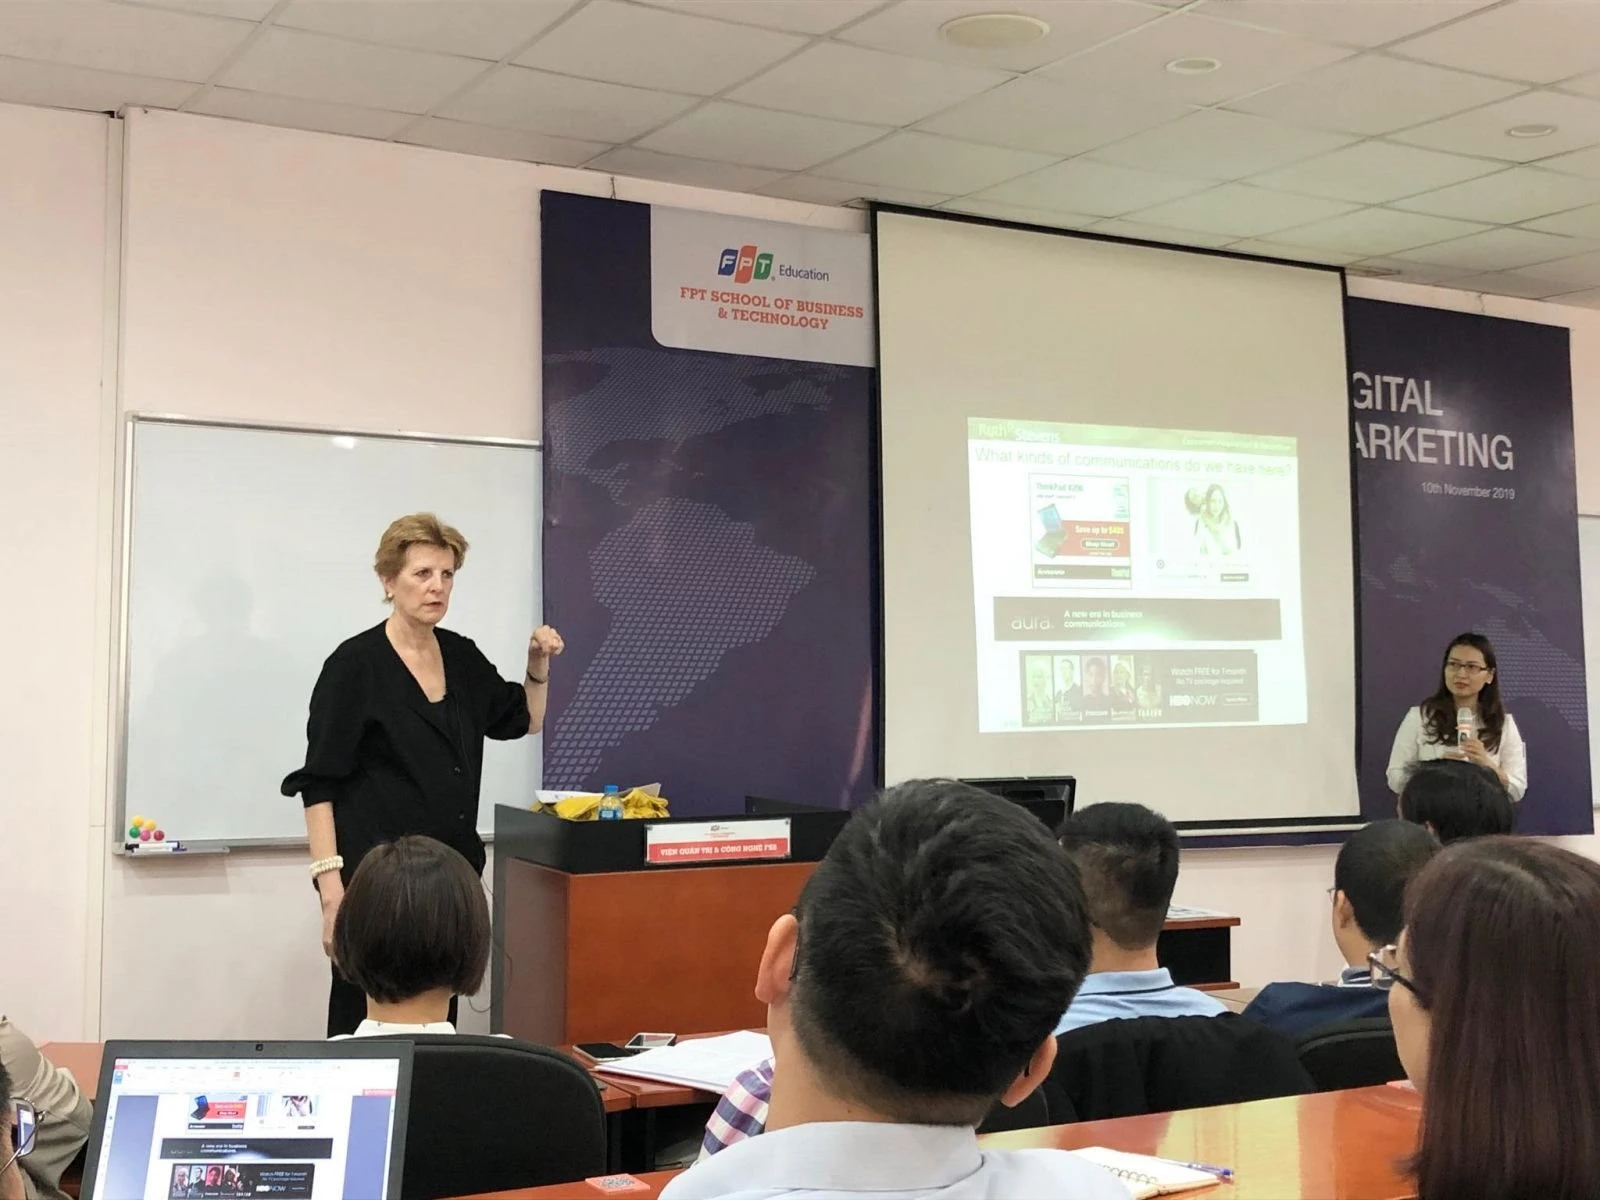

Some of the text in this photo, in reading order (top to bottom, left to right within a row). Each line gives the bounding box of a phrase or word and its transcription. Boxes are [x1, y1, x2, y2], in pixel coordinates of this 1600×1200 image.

[719, 252, 830, 281] FPT Education
[680, 287, 863, 318] FPT SCHOOL OF BUSINESS
[718, 307, 829, 330] & TECHNOLOGY
[1353, 371, 1443, 416] GITAL
[975, 447, 1012, 463] What
[1017, 450, 1053, 465] kinds
[1058, 451, 1071, 465] of
[1075, 454, 1180, 472] communications
[1185, 459, 1201, 472] do
[1205, 462, 1223, 472] we
[1227, 461, 1255, 474] have
[1422, 482, 1515, 499] 10th November 2019
[1064, 610, 1071, 618] A
[1103, 610, 1110, 618] in
[1111, 610, 1143, 618] business
[1194, 667, 1210, 675] FREE
